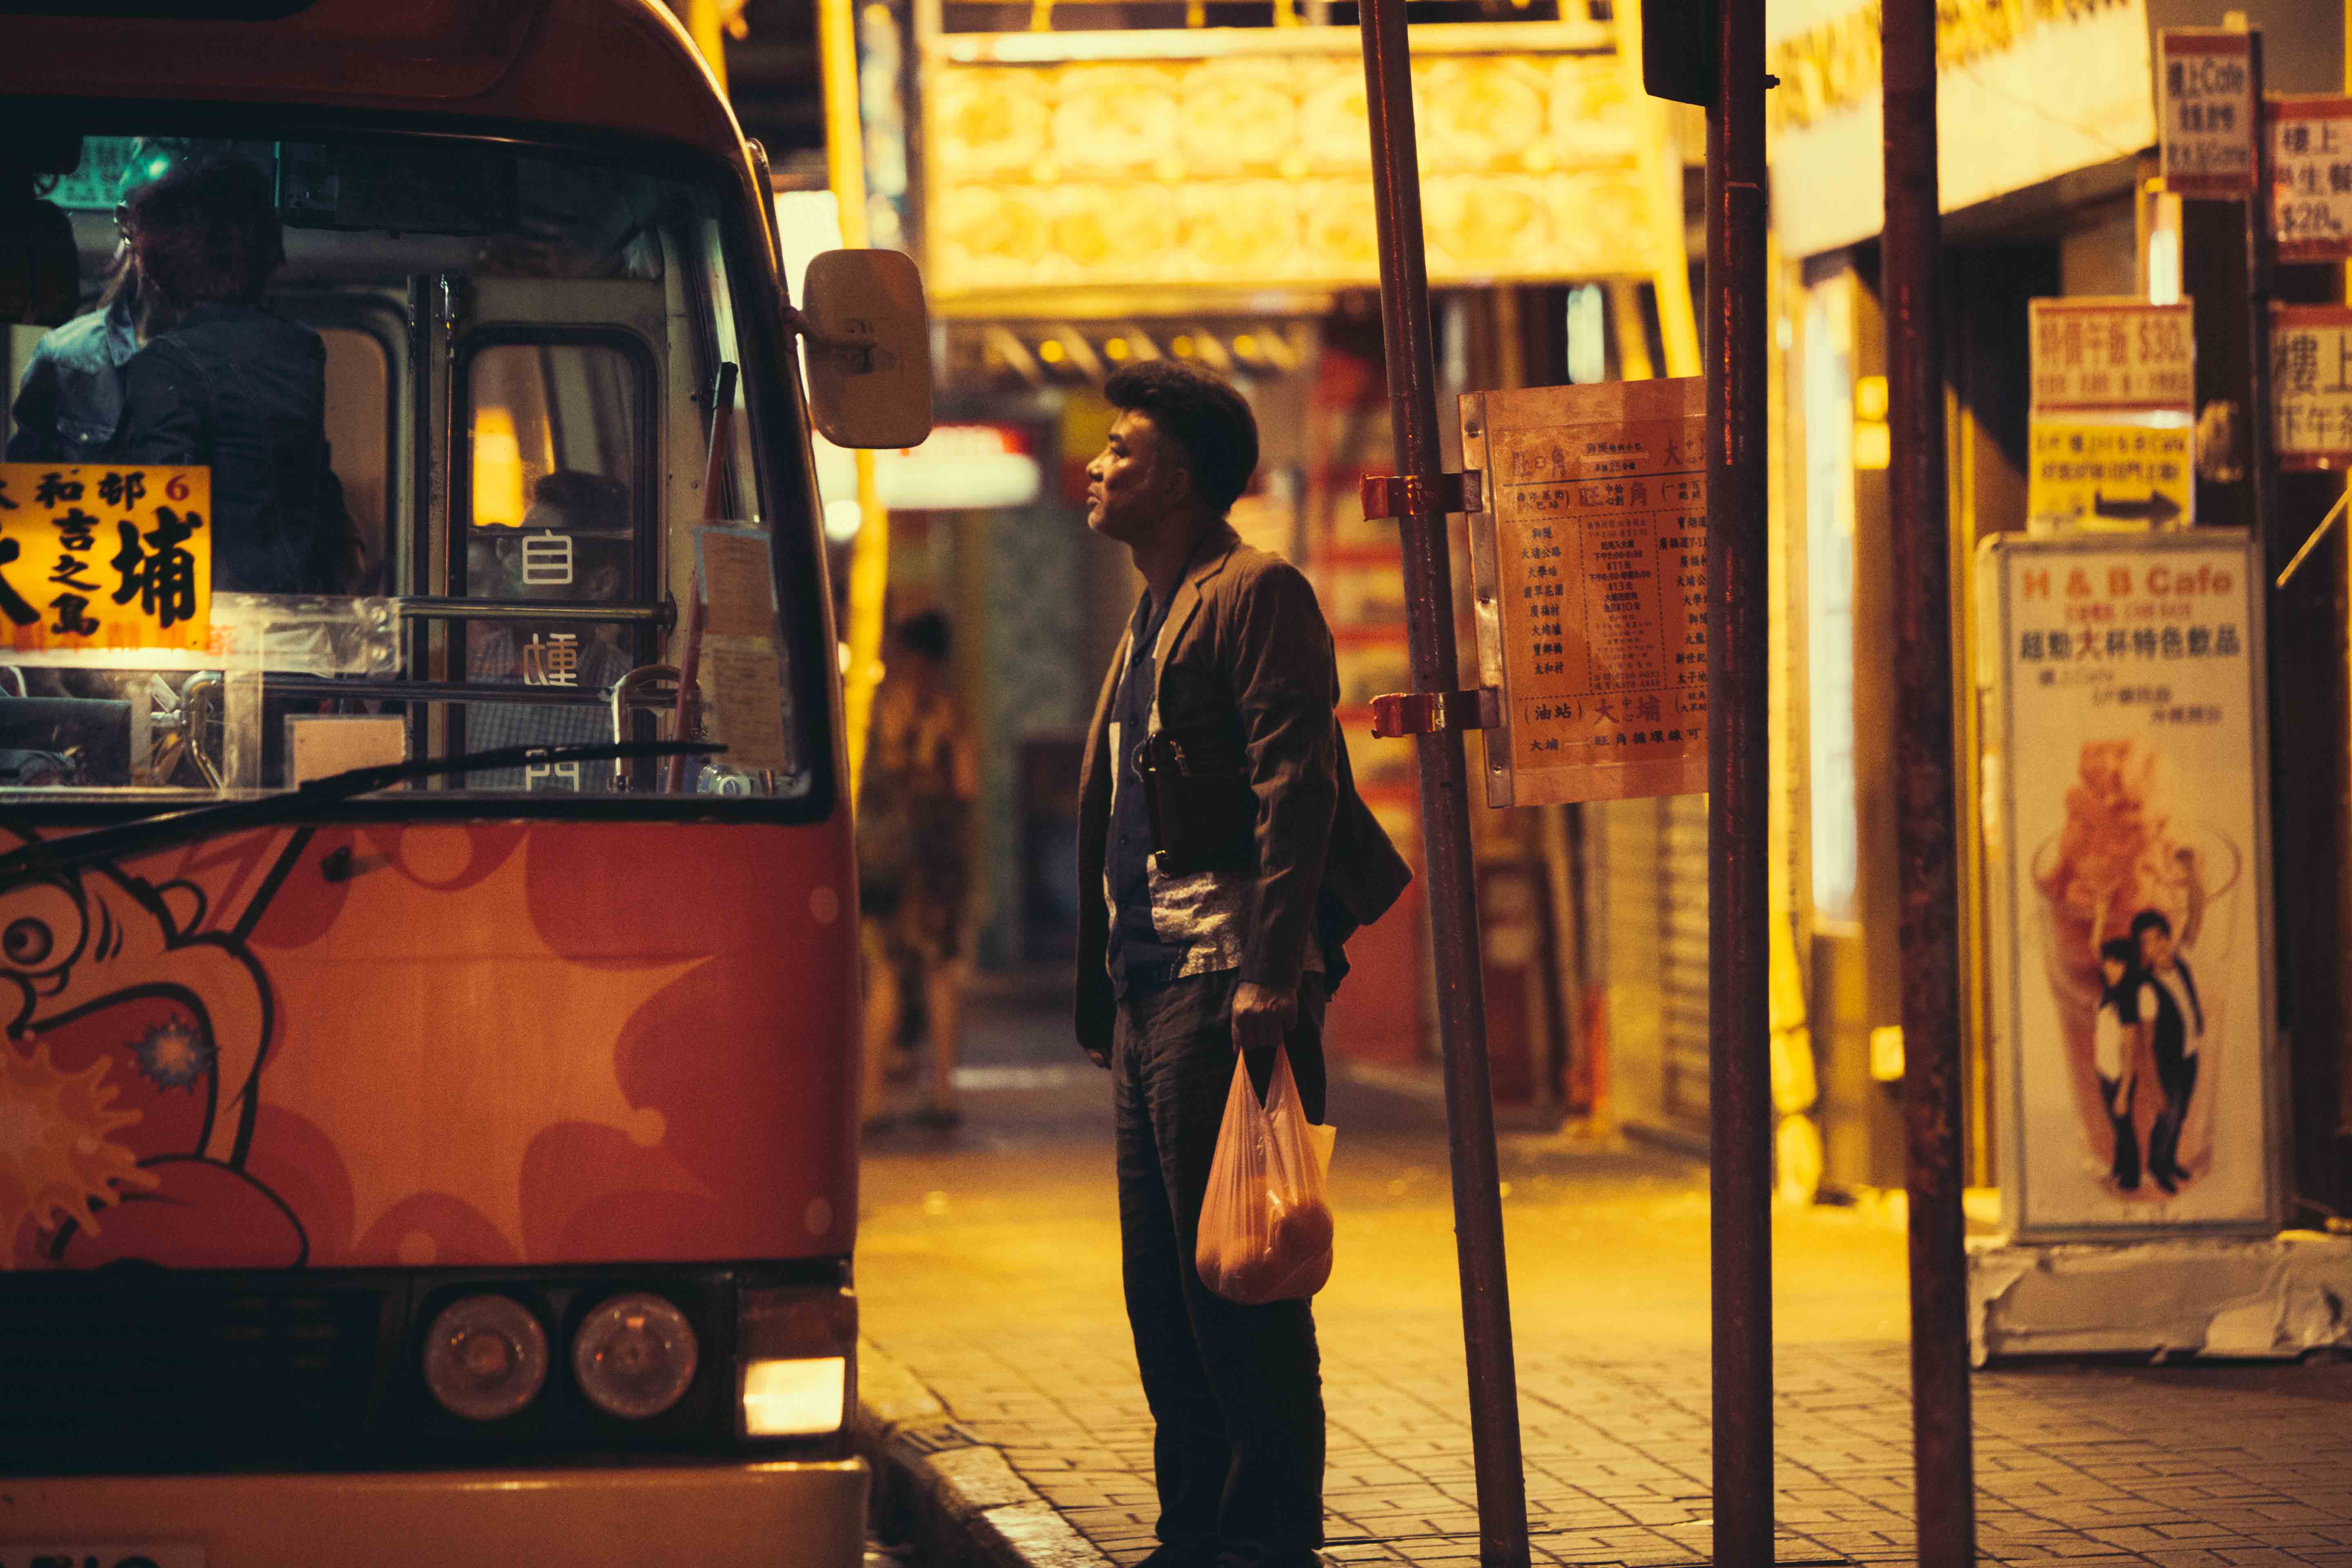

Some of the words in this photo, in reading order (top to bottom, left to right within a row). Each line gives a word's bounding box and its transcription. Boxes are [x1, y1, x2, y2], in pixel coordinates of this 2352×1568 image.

[165, 475, 189, 501] 6
[2022, 568, 2051, 599] H
[2146, 564, 2234, 597] Cafe
